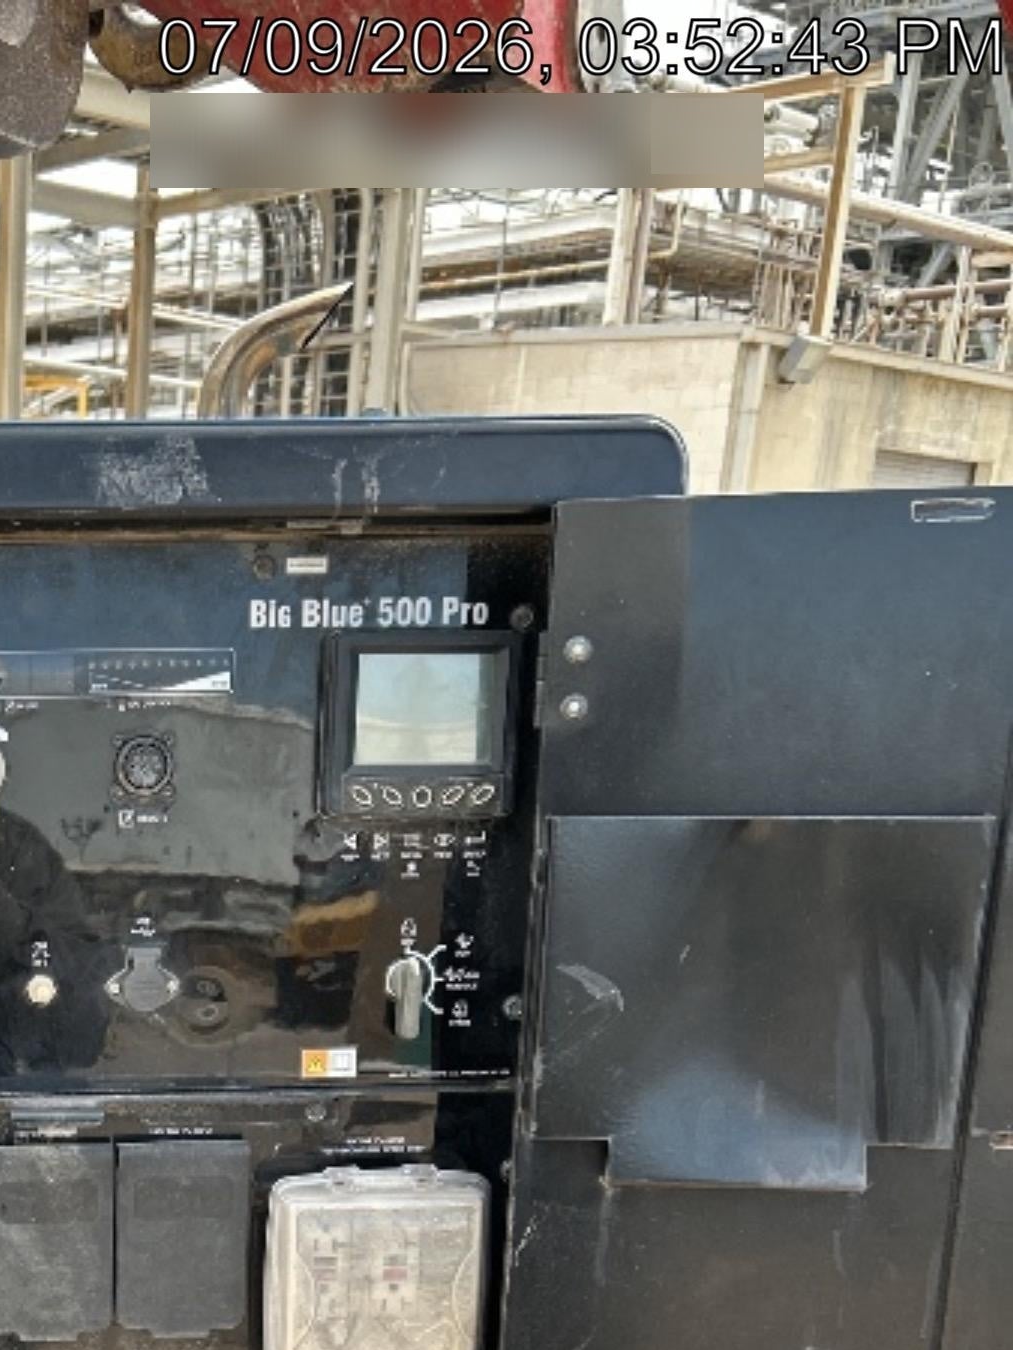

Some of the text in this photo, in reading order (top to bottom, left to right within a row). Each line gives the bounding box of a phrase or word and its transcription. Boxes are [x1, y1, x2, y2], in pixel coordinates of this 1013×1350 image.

[300, 599, 363, 629] Blue
[377, 597, 432, 627] 500
[442, 597, 490, 626] Pro
